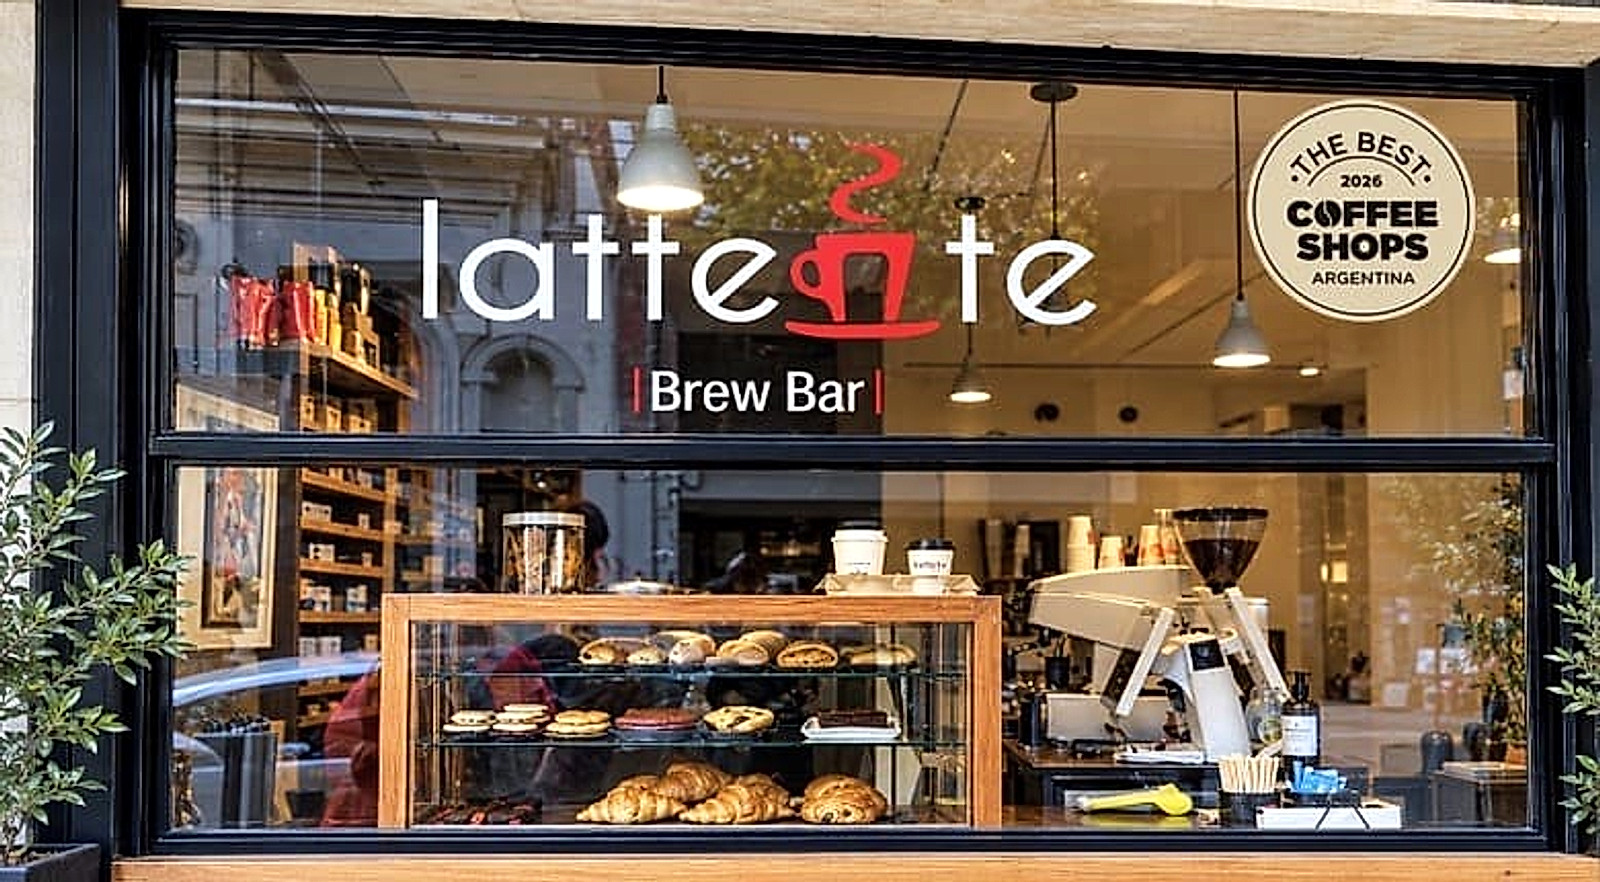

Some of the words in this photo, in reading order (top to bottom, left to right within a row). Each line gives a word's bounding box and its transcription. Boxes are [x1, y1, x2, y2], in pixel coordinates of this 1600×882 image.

[1290, 134, 1347, 174] THE
[1358, 131, 1431, 173] BEST
[1340, 174, 1383, 188] 2026
[1287, 200, 1438, 228] COFFEE
[1297, 233, 1429, 261] SHOPS
[1312, 271, 1416, 285] ARGENTINA
[651, 370, 771, 412] Brew
[786, 370, 864, 412] Bar
